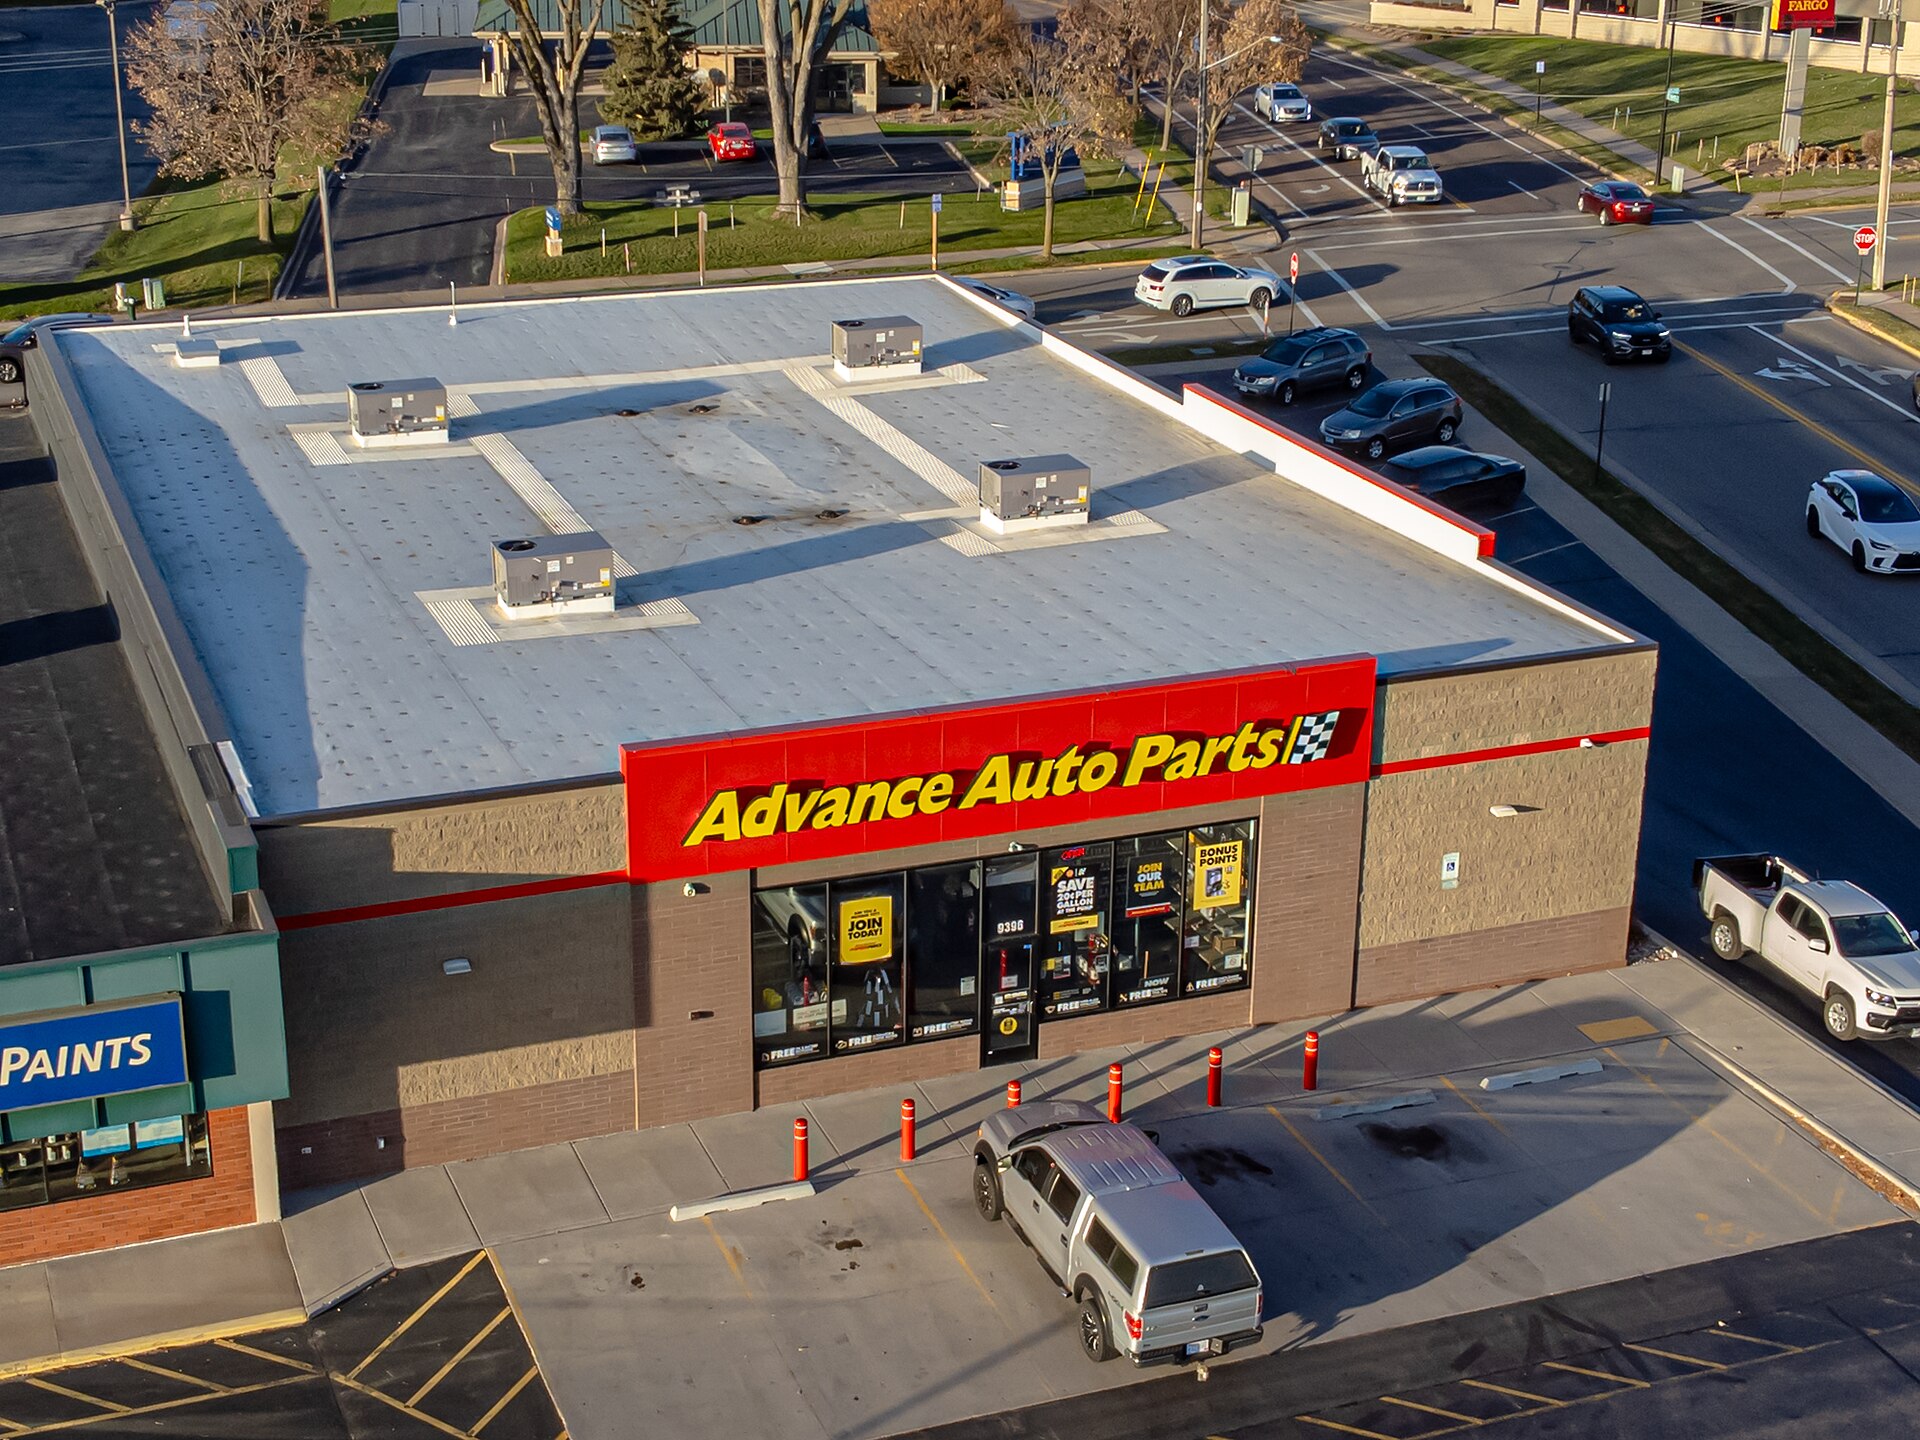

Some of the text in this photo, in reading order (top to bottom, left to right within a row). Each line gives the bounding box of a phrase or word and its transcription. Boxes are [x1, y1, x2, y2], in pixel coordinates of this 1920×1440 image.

[1788, 0, 1828, 11] FARGO
[1856, 233, 1876, 243] STOP
[683, 722, 1284, 847] Advance Auto Parts
[1200, 844, 1238, 858] BONUS
[1200, 853, 1238, 867] POINTS
[1137, 862, 1162, 874] JOIN
[1137, 871, 1162, 882] OUR
[1057, 876, 1095, 893] SAVE
[1134, 880, 1165, 892] TEAM
[1075, 889, 1094, 900] PER
[1057, 898, 1093, 909] GALLON
[848, 916, 883, 932] JOIN
[848, 928, 883, 940] TODAY!
[1144, 977, 1170, 988] NOW
[1195, 979, 1218, 989] FREE
[1129, 989, 1152, 1001] FREE
[1057, 1000, 1081, 1012] FREE
[923, 1024, 947, 1035] FREE
[848, 1034, 872, 1047] FREE
[0, 1033, 152, 1086] PAINTS
[770, 1049, 795, 1061] FREE
